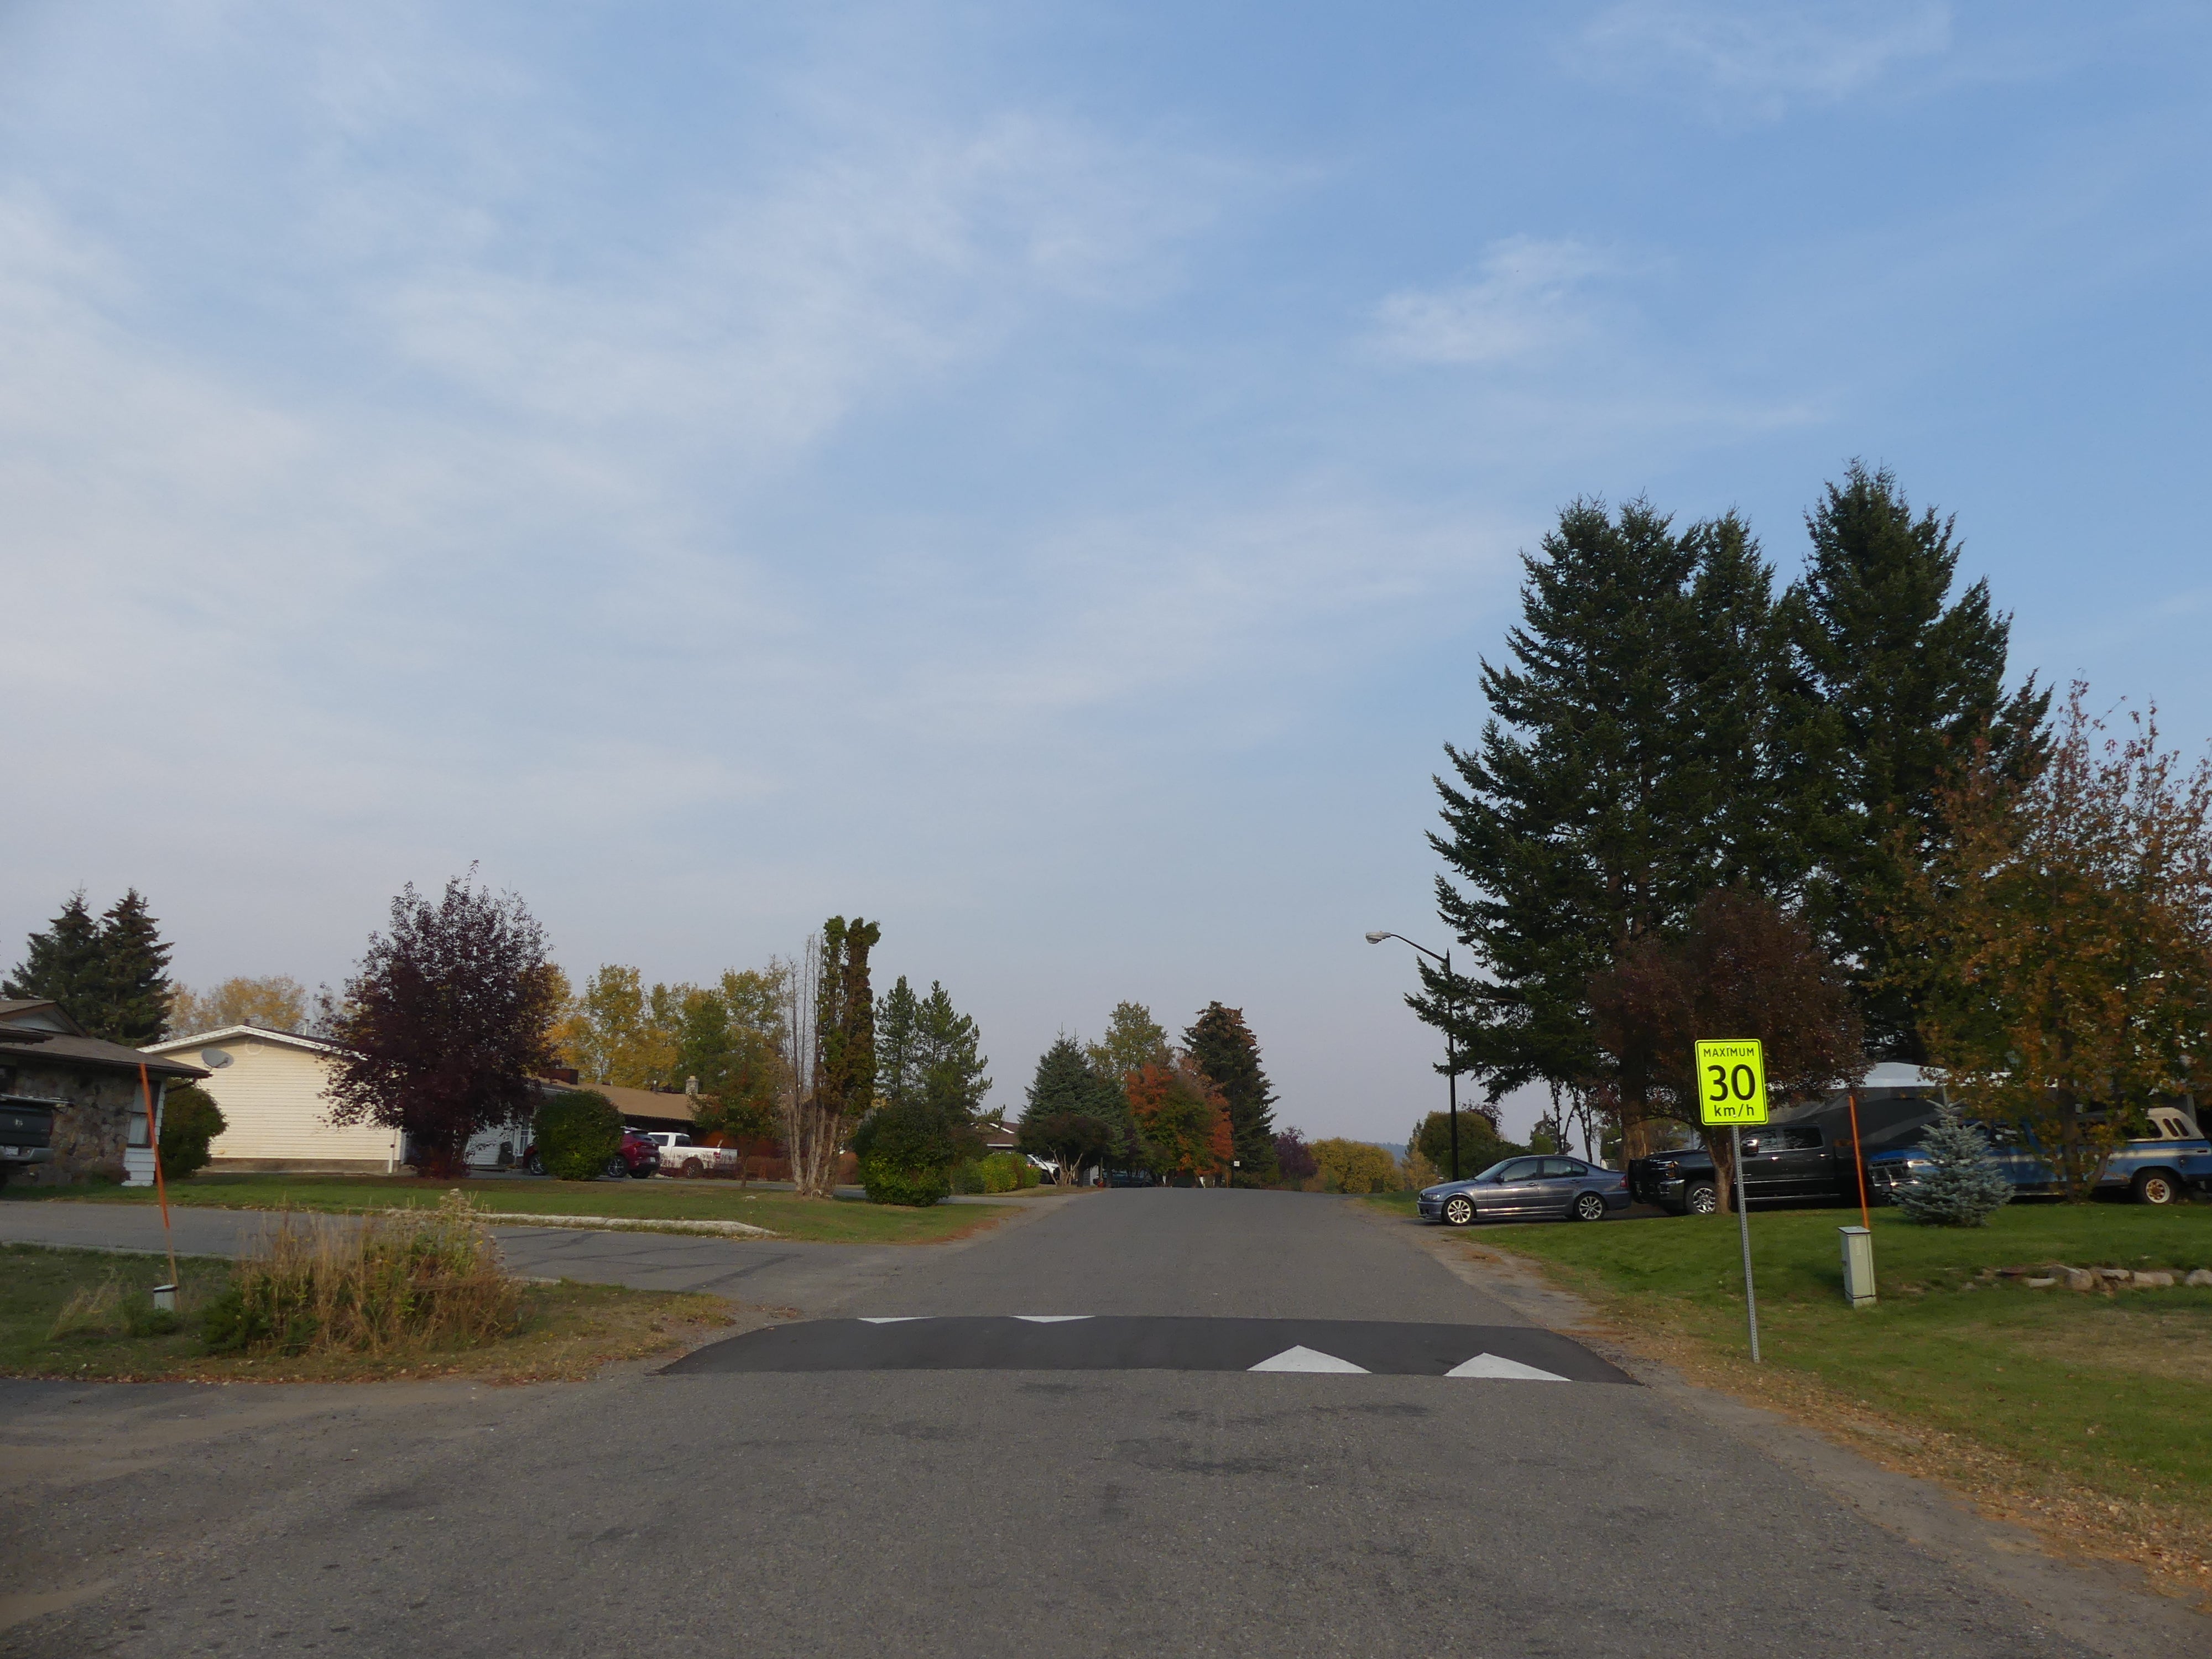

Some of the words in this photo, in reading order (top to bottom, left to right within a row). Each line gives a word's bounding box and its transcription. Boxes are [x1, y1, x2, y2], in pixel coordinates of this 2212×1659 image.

[1703, 1048, 1754, 1057] MAXIMUM
[1707, 1064, 1755, 1101] 30
[1714, 1104, 1754, 1117] km/h
